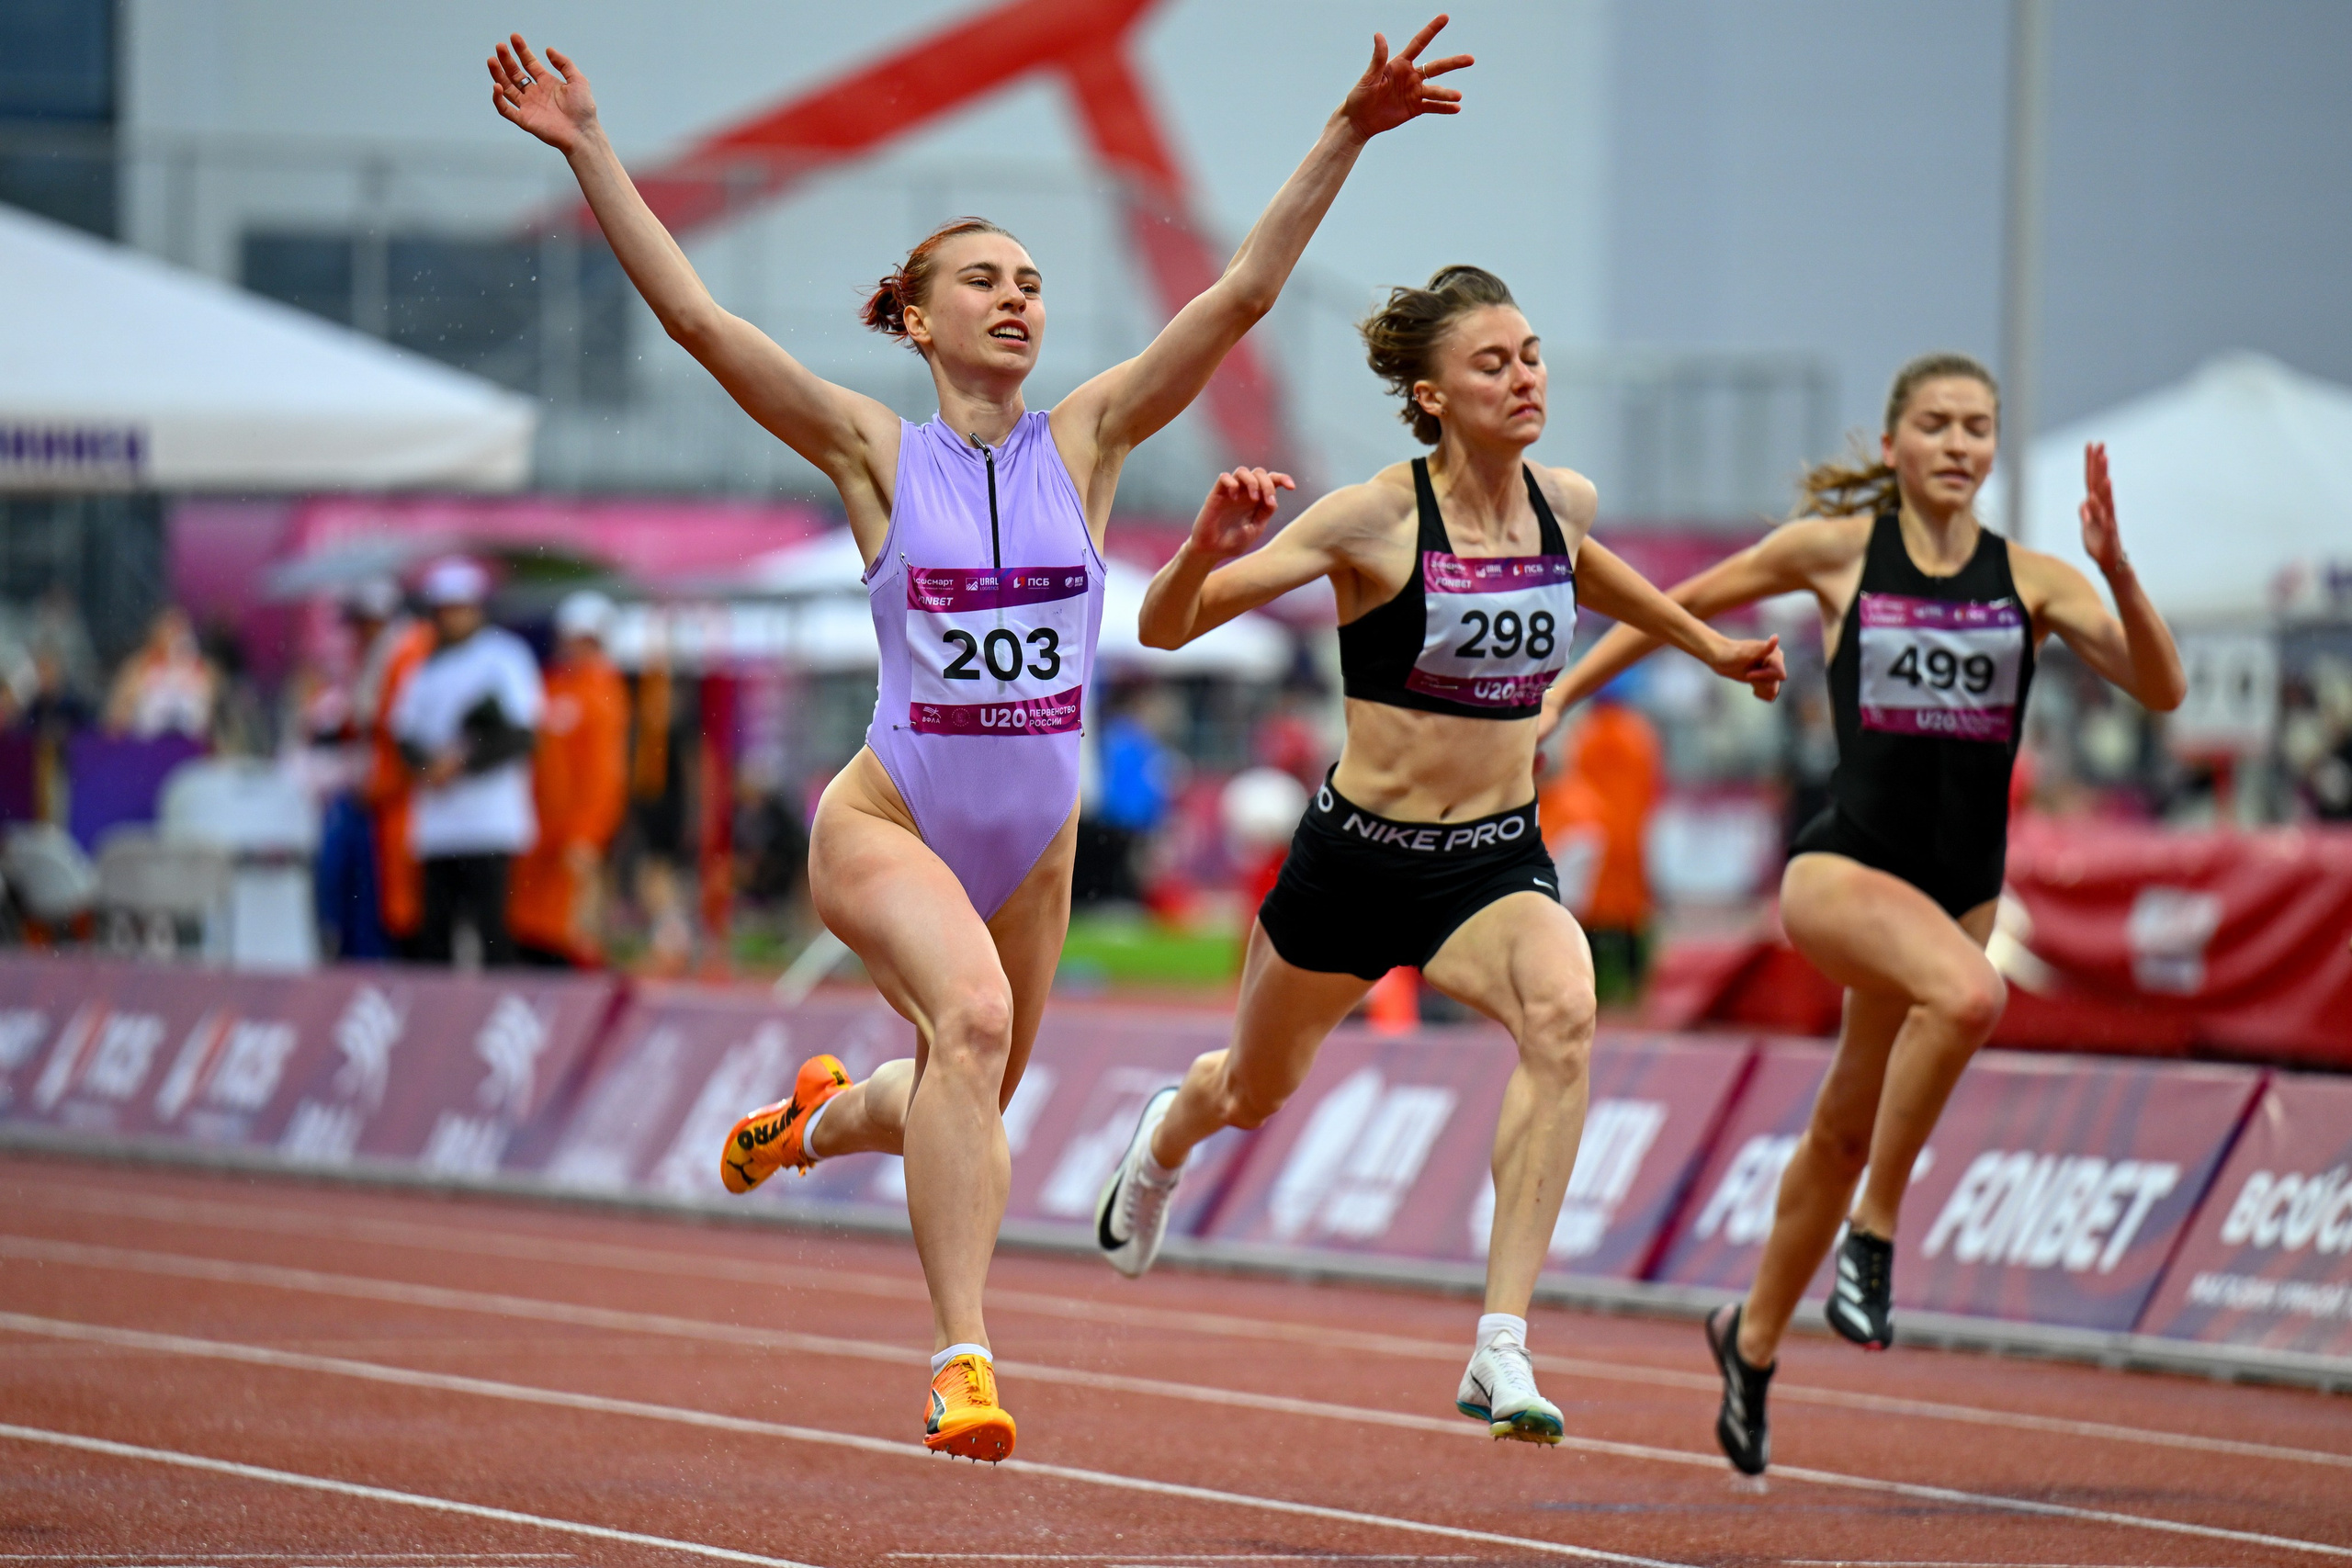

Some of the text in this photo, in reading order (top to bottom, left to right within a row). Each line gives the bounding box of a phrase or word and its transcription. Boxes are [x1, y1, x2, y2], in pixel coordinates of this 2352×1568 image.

[979, 577, 999, 585] URAL
[1027, 577, 1050, 586] ПСБ
[1454, 610, 1555, 660] 298
[943, 627, 1060, 682] 203
[1888, 646, 1994, 694] 499
[1474, 681, 1515, 701] U20
[980, 707, 1027, 728] U20
[1029, 705, 1077, 717] ПЕРВЕНСТВО
[1029, 717, 1062, 728] РОССИИ
[1342, 812, 1442, 852] NIKE
[1444, 815, 1525, 852] PRO
[1921, 1151, 2181, 1274] FONBET
